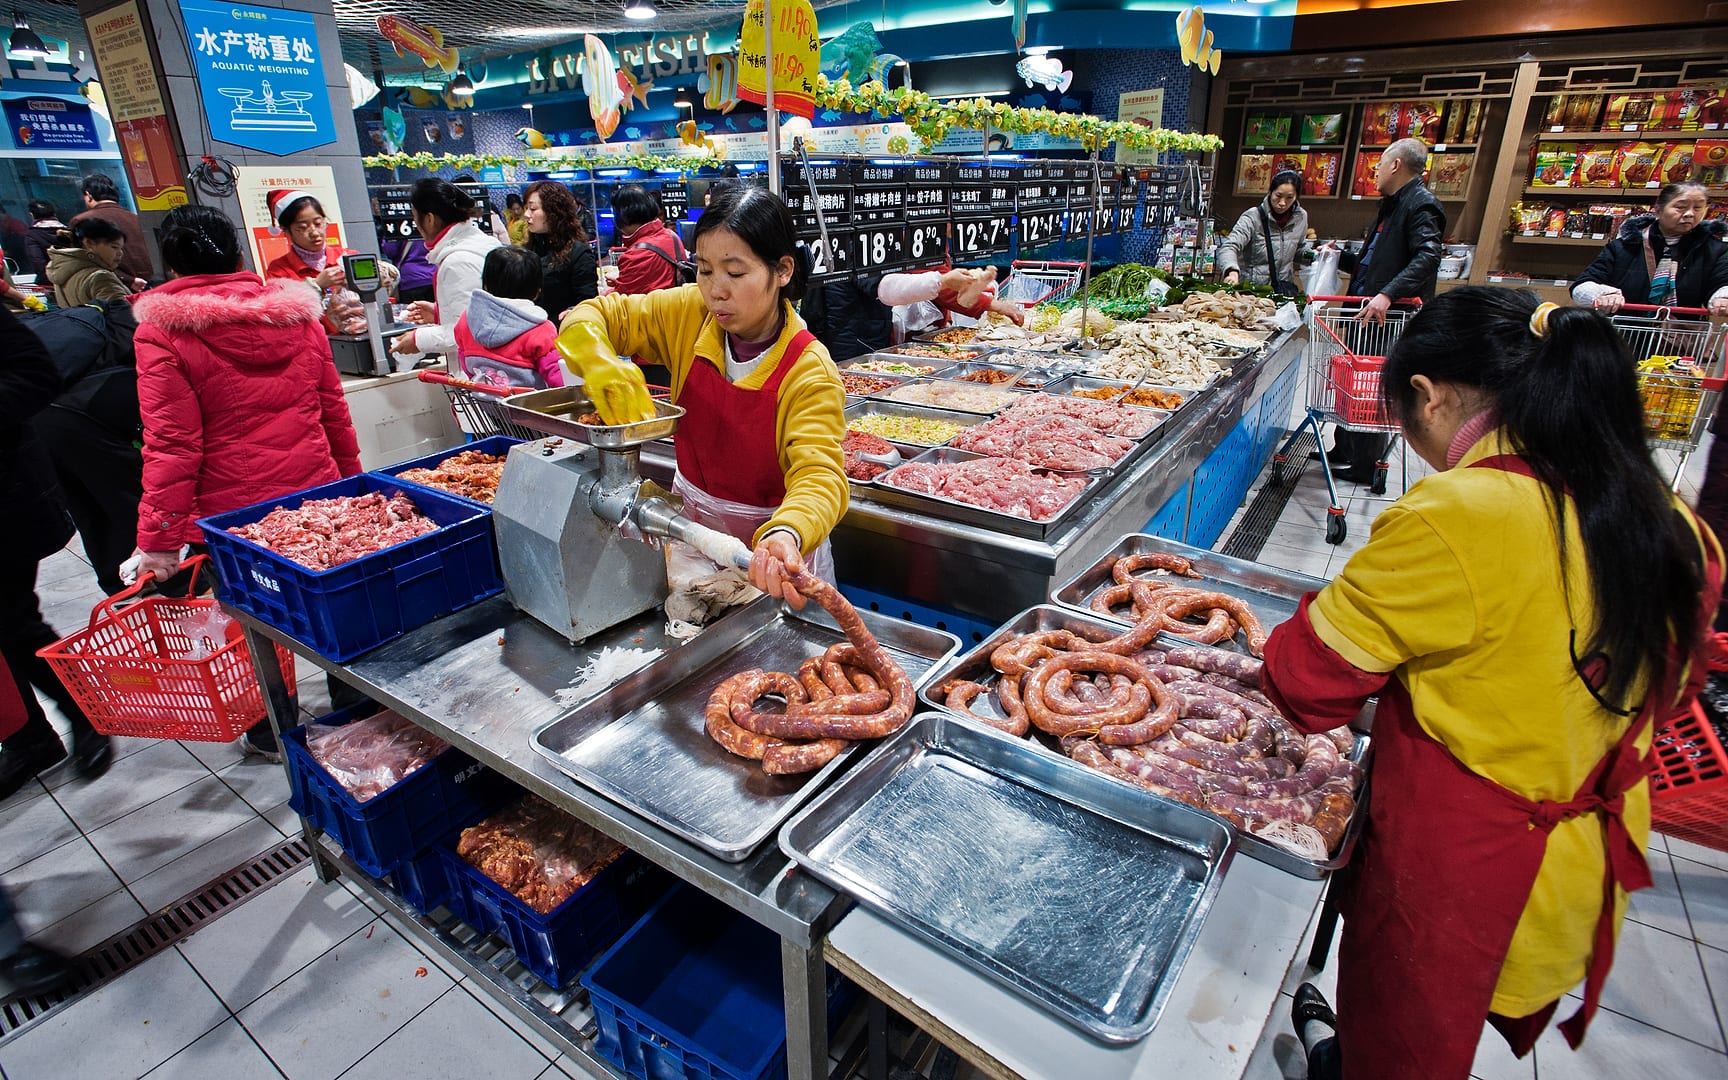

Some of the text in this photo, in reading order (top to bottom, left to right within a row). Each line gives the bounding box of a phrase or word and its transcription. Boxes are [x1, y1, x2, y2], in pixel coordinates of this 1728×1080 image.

[780, 6, 811, 40] 11.90
[195, 27, 315, 64] 水产称重处
[615, 30, 710, 80] FISH
[212, 61, 309, 76] AQUATIC WEIGHTING
[774, 52, 805, 81] 11.90
[261, 178, 312, 186] 计量员行为准则
[863, 168, 894, 180] 商品价格牌
